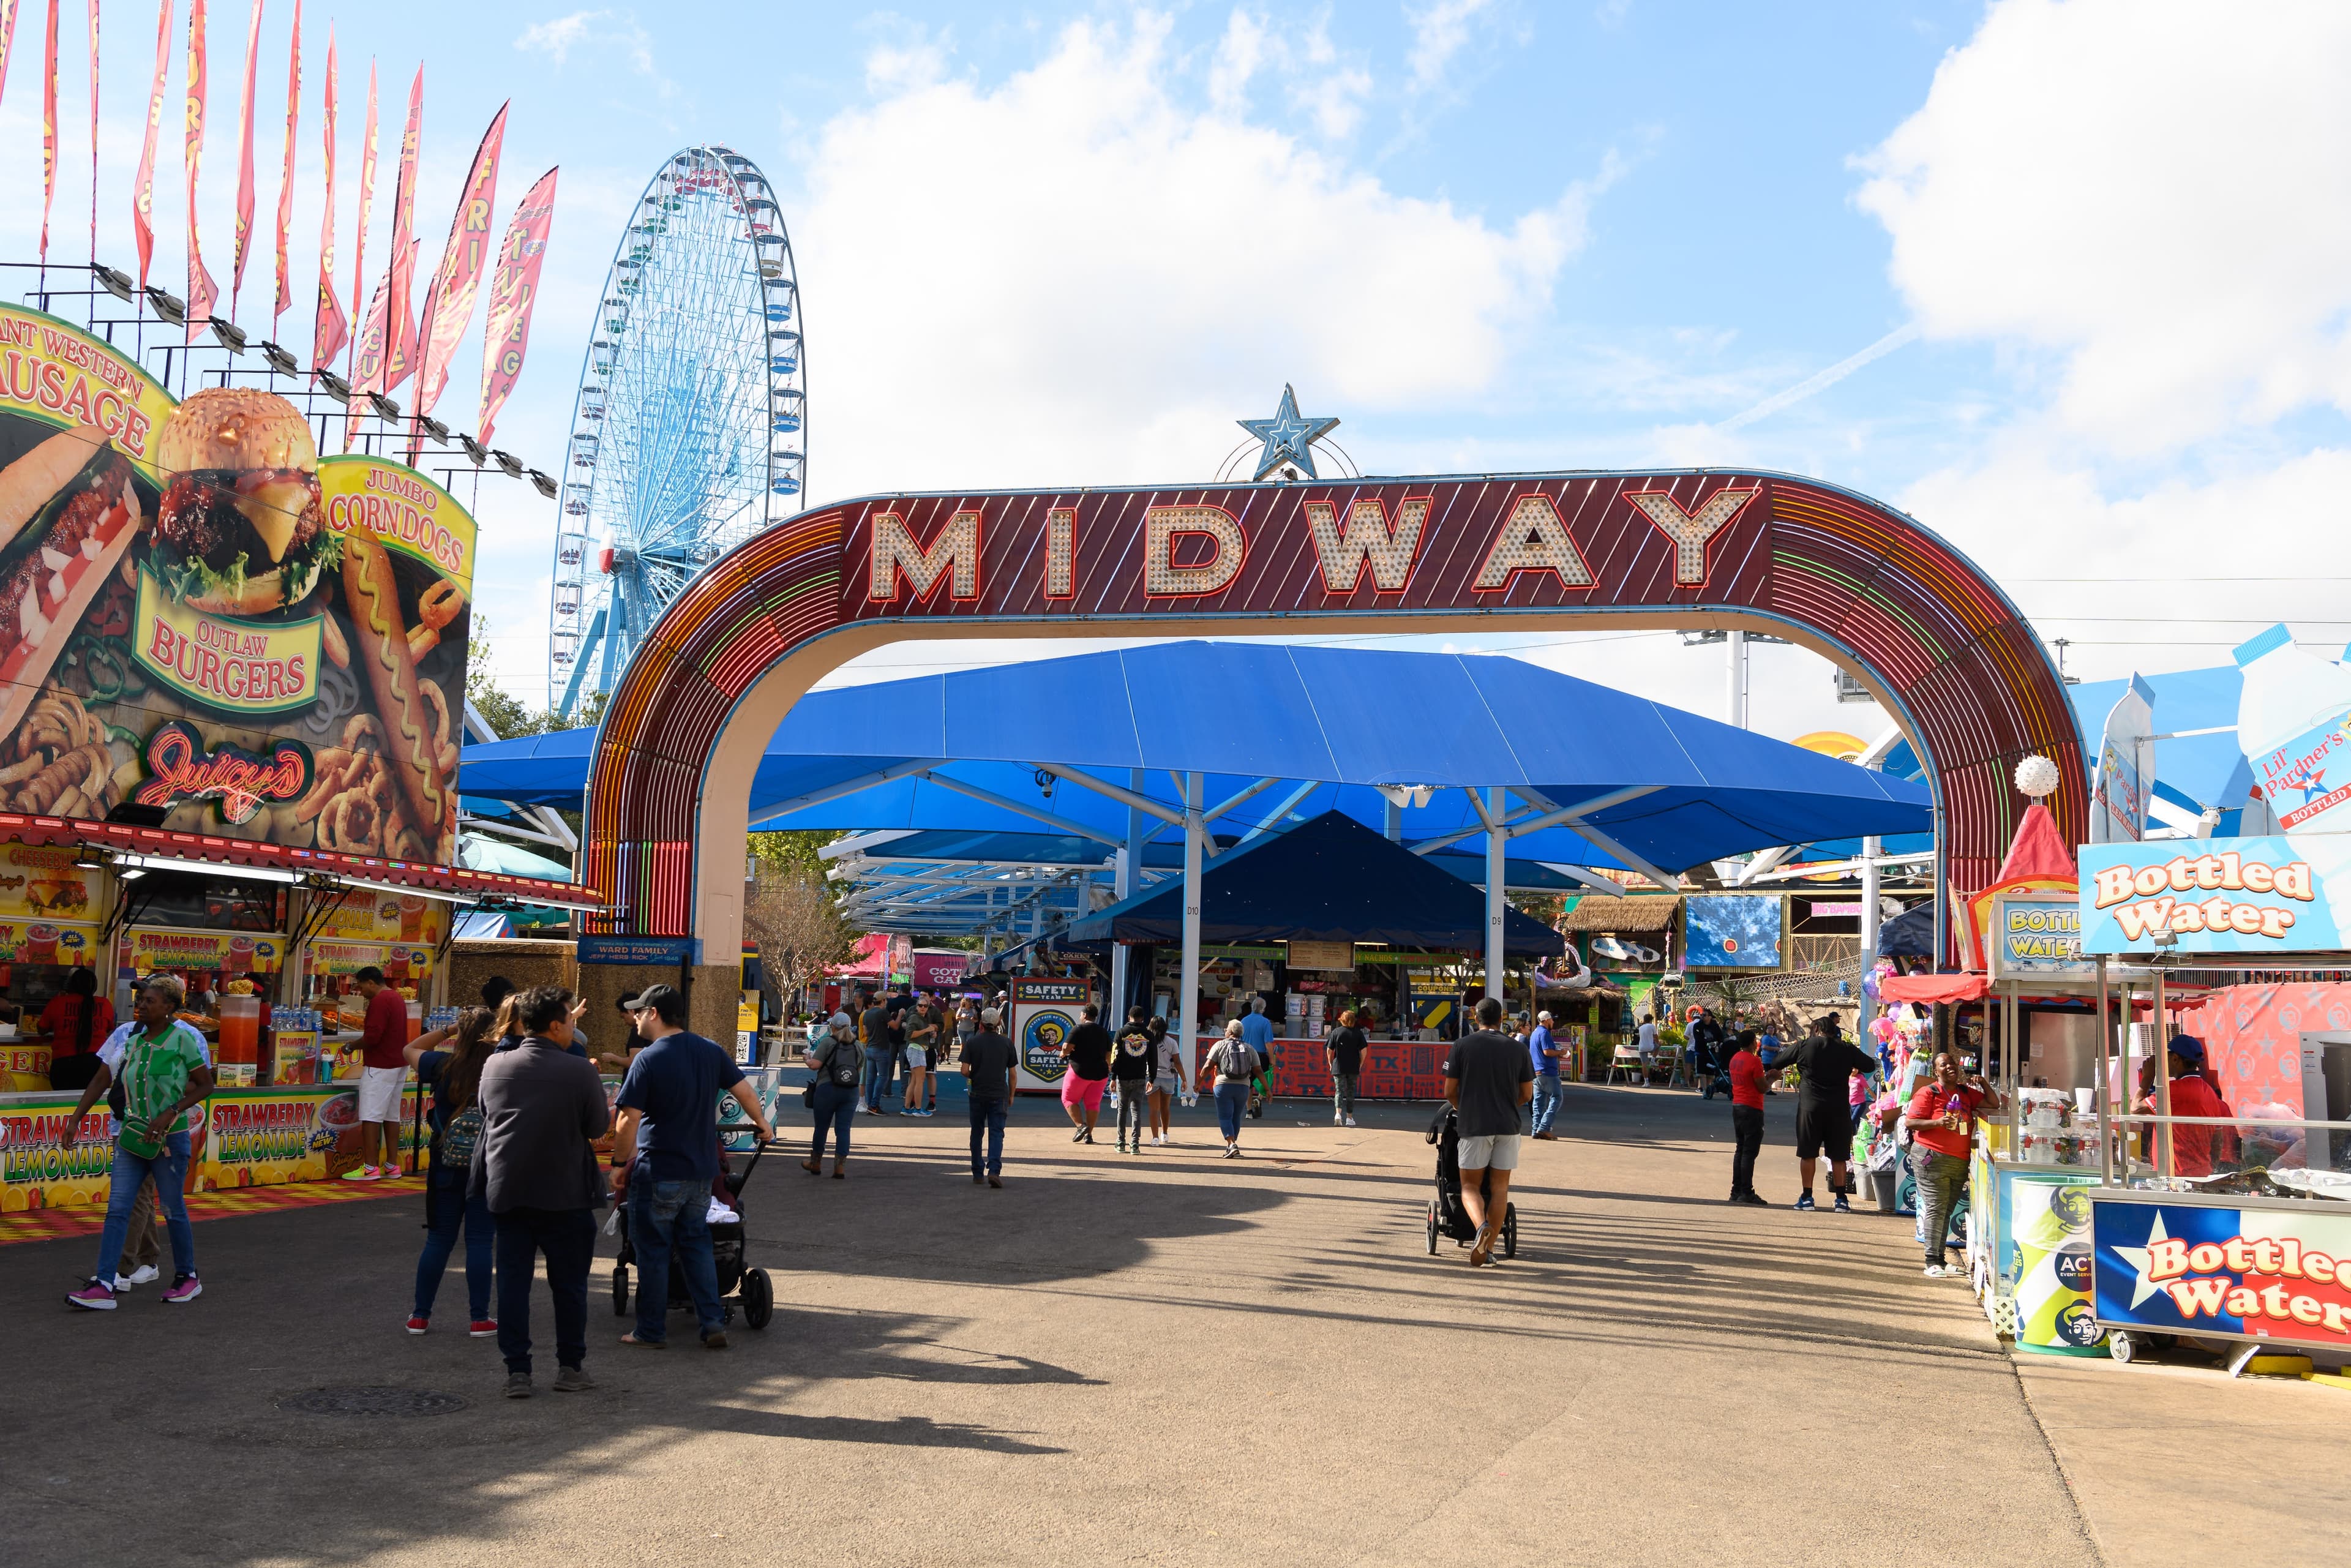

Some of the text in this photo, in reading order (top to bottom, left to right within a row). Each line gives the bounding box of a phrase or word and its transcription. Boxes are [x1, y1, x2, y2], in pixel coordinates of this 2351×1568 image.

[42, 326, 144, 403] WESTERN
[366, 468, 438, 511] JUMBO
[329, 494, 464, 572] CORN DOGS
[868, 487, 1763, 602] MIDWAY
[197, 620, 269, 657] OUTLAW
[149, 614, 306, 699] BURGERS
[2264, 732, 2344, 798] Pardner's
[2290, 789, 2347, 823] BOTTLED
[2123, 817, 2139, 839] WATER
[2094, 852, 2315, 909] Bottled
[316, 907, 374, 931] LEMONADE
[1492, 917, 1501, 926] D9
[2113, 896, 2295, 941] Water
[139, 934, 220, 952] STRAWBERRY
[318, 945, 383, 959] STRAWBERRY
[2010, 936, 2080, 957] WATE
[154, 950, 222, 969] LEMONADE
[1365, 954, 1392, 962] NACHOS
[891, 972, 910, 985] BEER
[1026, 985, 1077, 995] SAFETY
[1029, 1018, 1041, 1029] STATE
[1059, 1017, 1071, 1029] TEXAS
[1371, 1056, 1400, 1069] TX
[212, 1103, 315, 1132] STRAWBERRY
[218, 1131, 307, 1161] LEMONADE
[312, 1131, 334, 1149] ALL NEW!
[2168, 1277, 2351, 1335] Water
